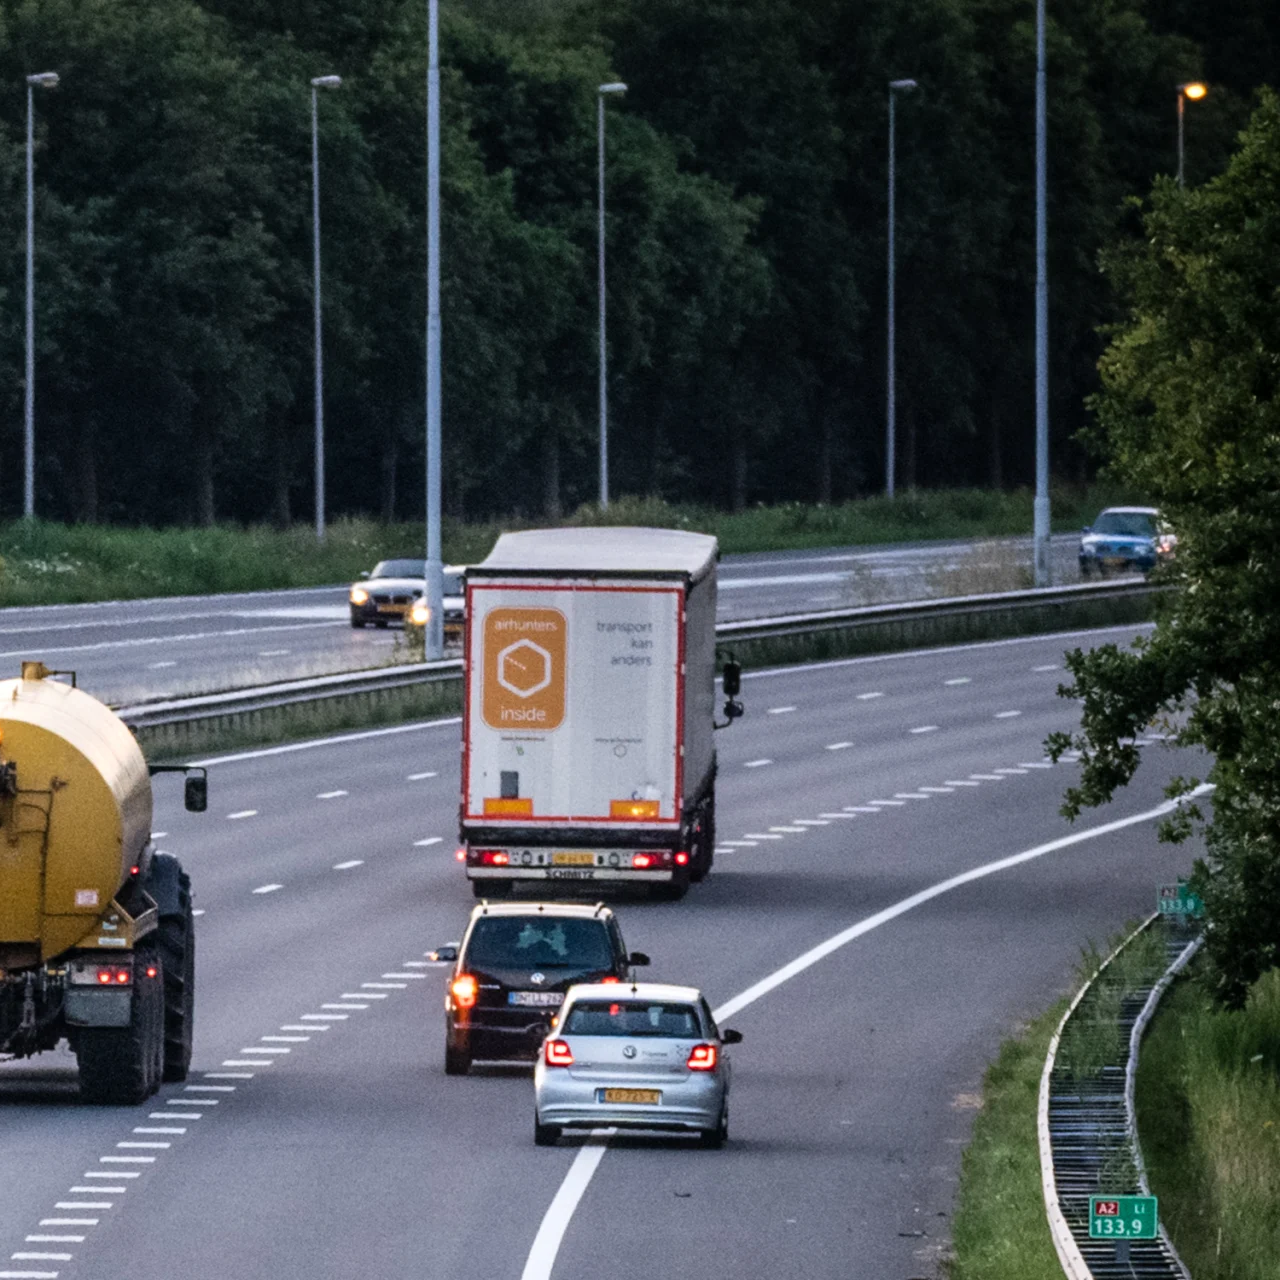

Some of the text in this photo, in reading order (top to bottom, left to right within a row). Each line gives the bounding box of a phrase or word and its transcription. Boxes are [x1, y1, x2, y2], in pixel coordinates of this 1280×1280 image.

[495, 619, 557, 632] airhunters
[596, 620, 653, 634] transport
[631, 637, 653, 648] kan
[611, 654, 652, 667] anders
[500, 705, 547, 722] inside
[1098, 1203, 1115, 1214] A2
[1094, 1218, 1143, 1236] 133,9
